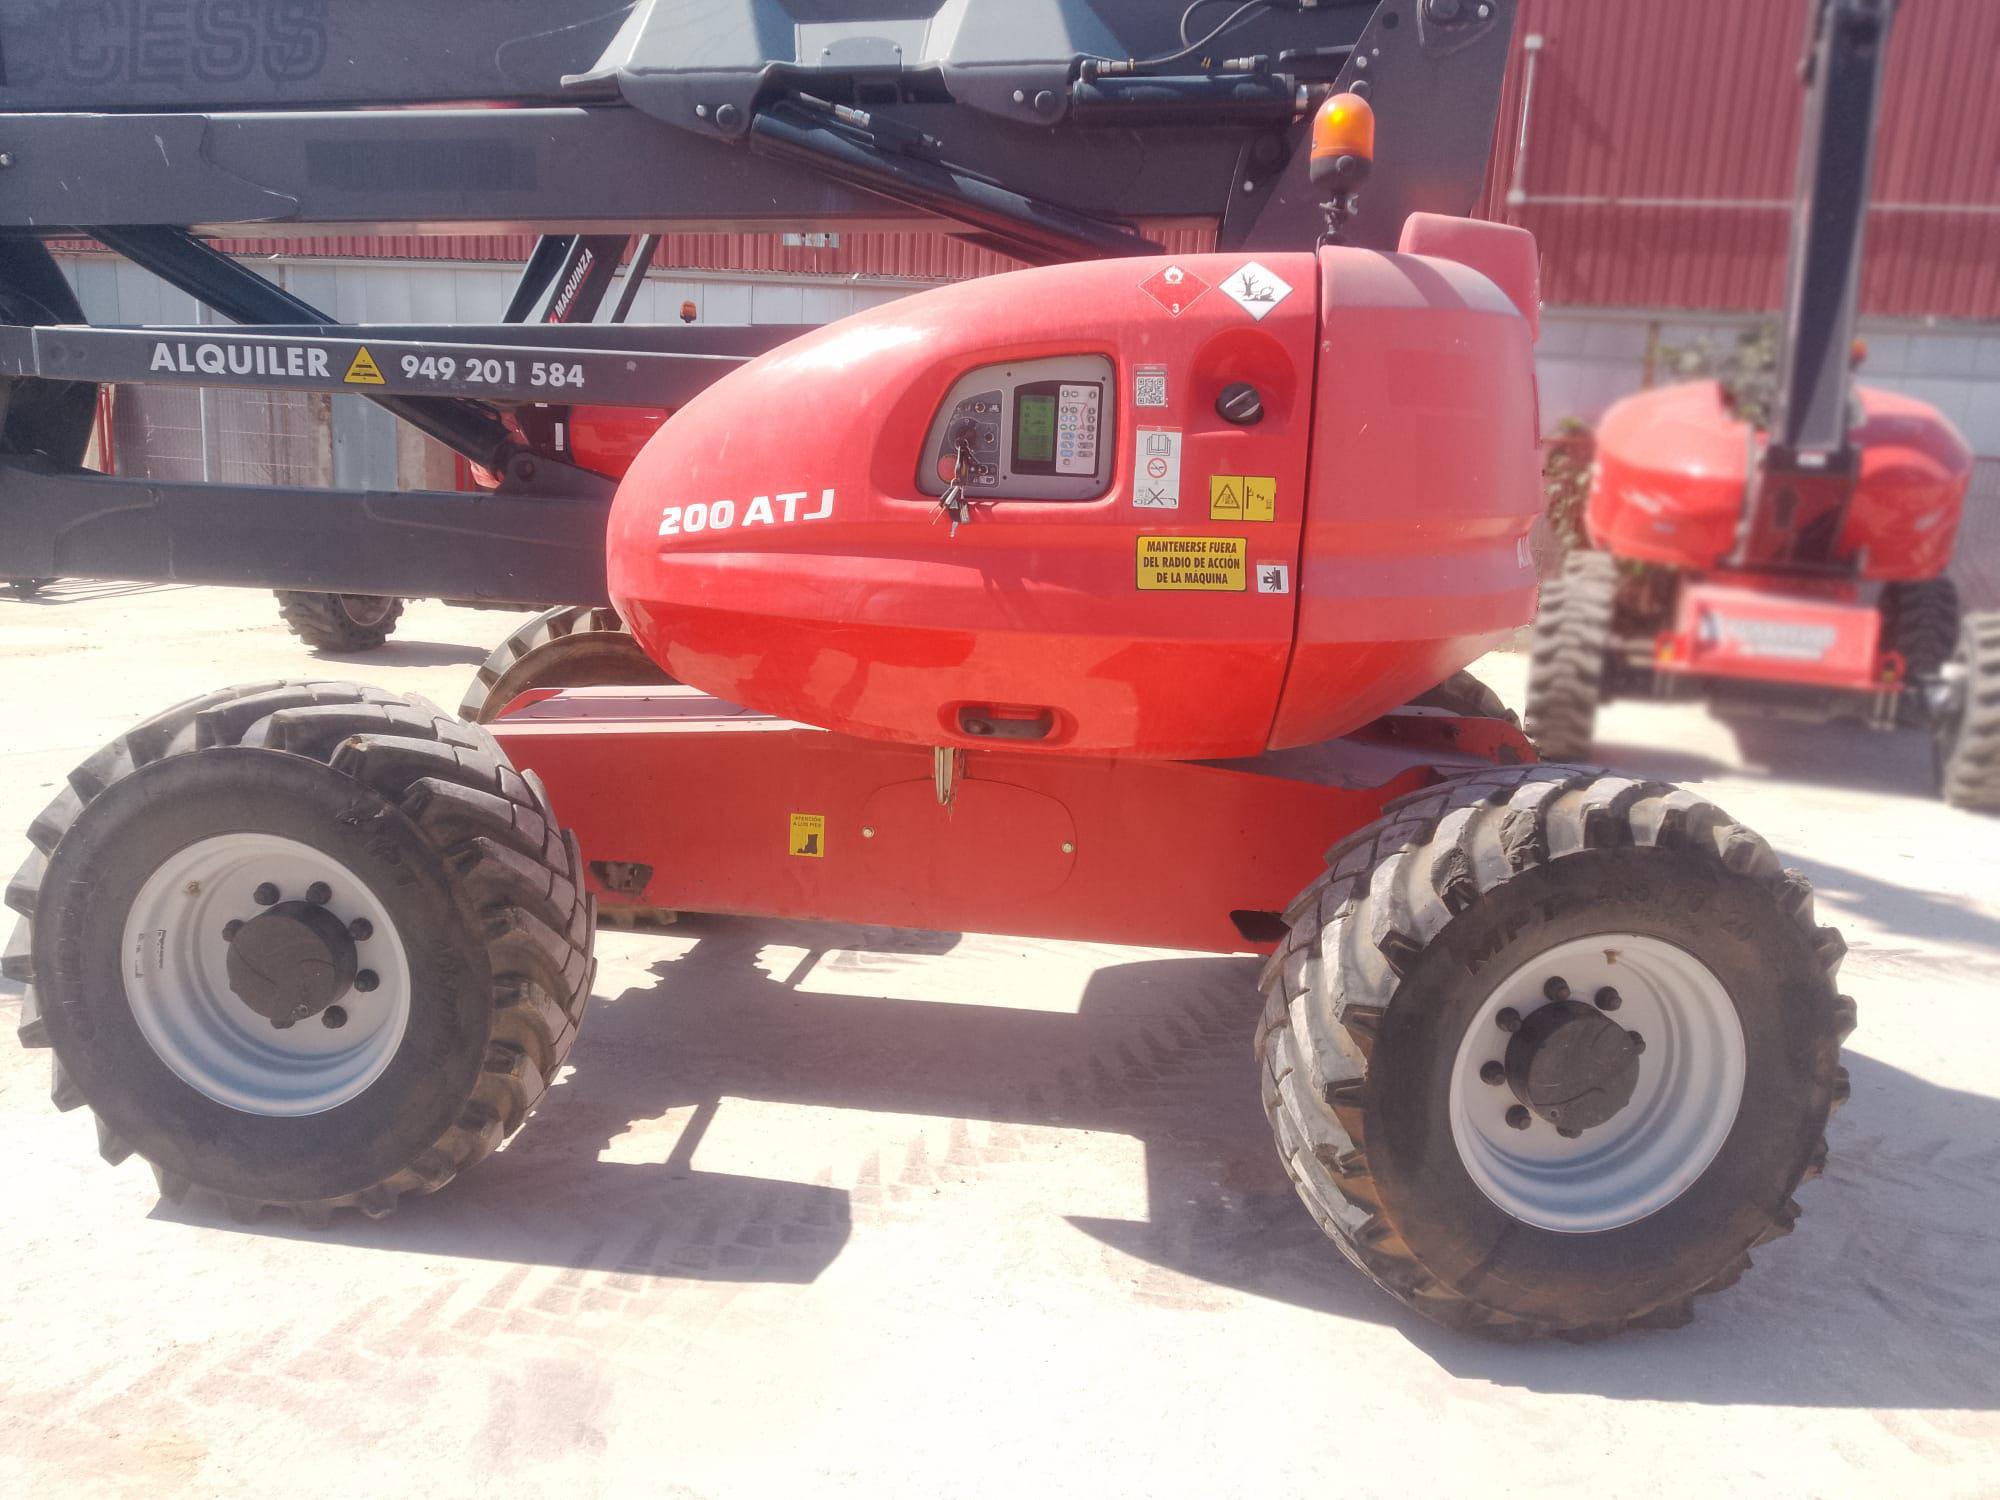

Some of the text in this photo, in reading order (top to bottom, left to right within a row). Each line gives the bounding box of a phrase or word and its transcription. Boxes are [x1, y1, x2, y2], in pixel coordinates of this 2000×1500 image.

[554, 247, 593, 318] MAQUINZA
[1172, 303, 1180, 313] 3
[150, 342, 585, 388] ALQUILER 949 201 584
[658, 488, 835, 536] 200 ATJ
[1147, 541, 1237, 553] MANTENERSE FUERA
[1143, 554, 1240, 569] DEL RADIO DE ACCIÓN
[1156, 570, 1228, 584] DE LA MÁQUINA
